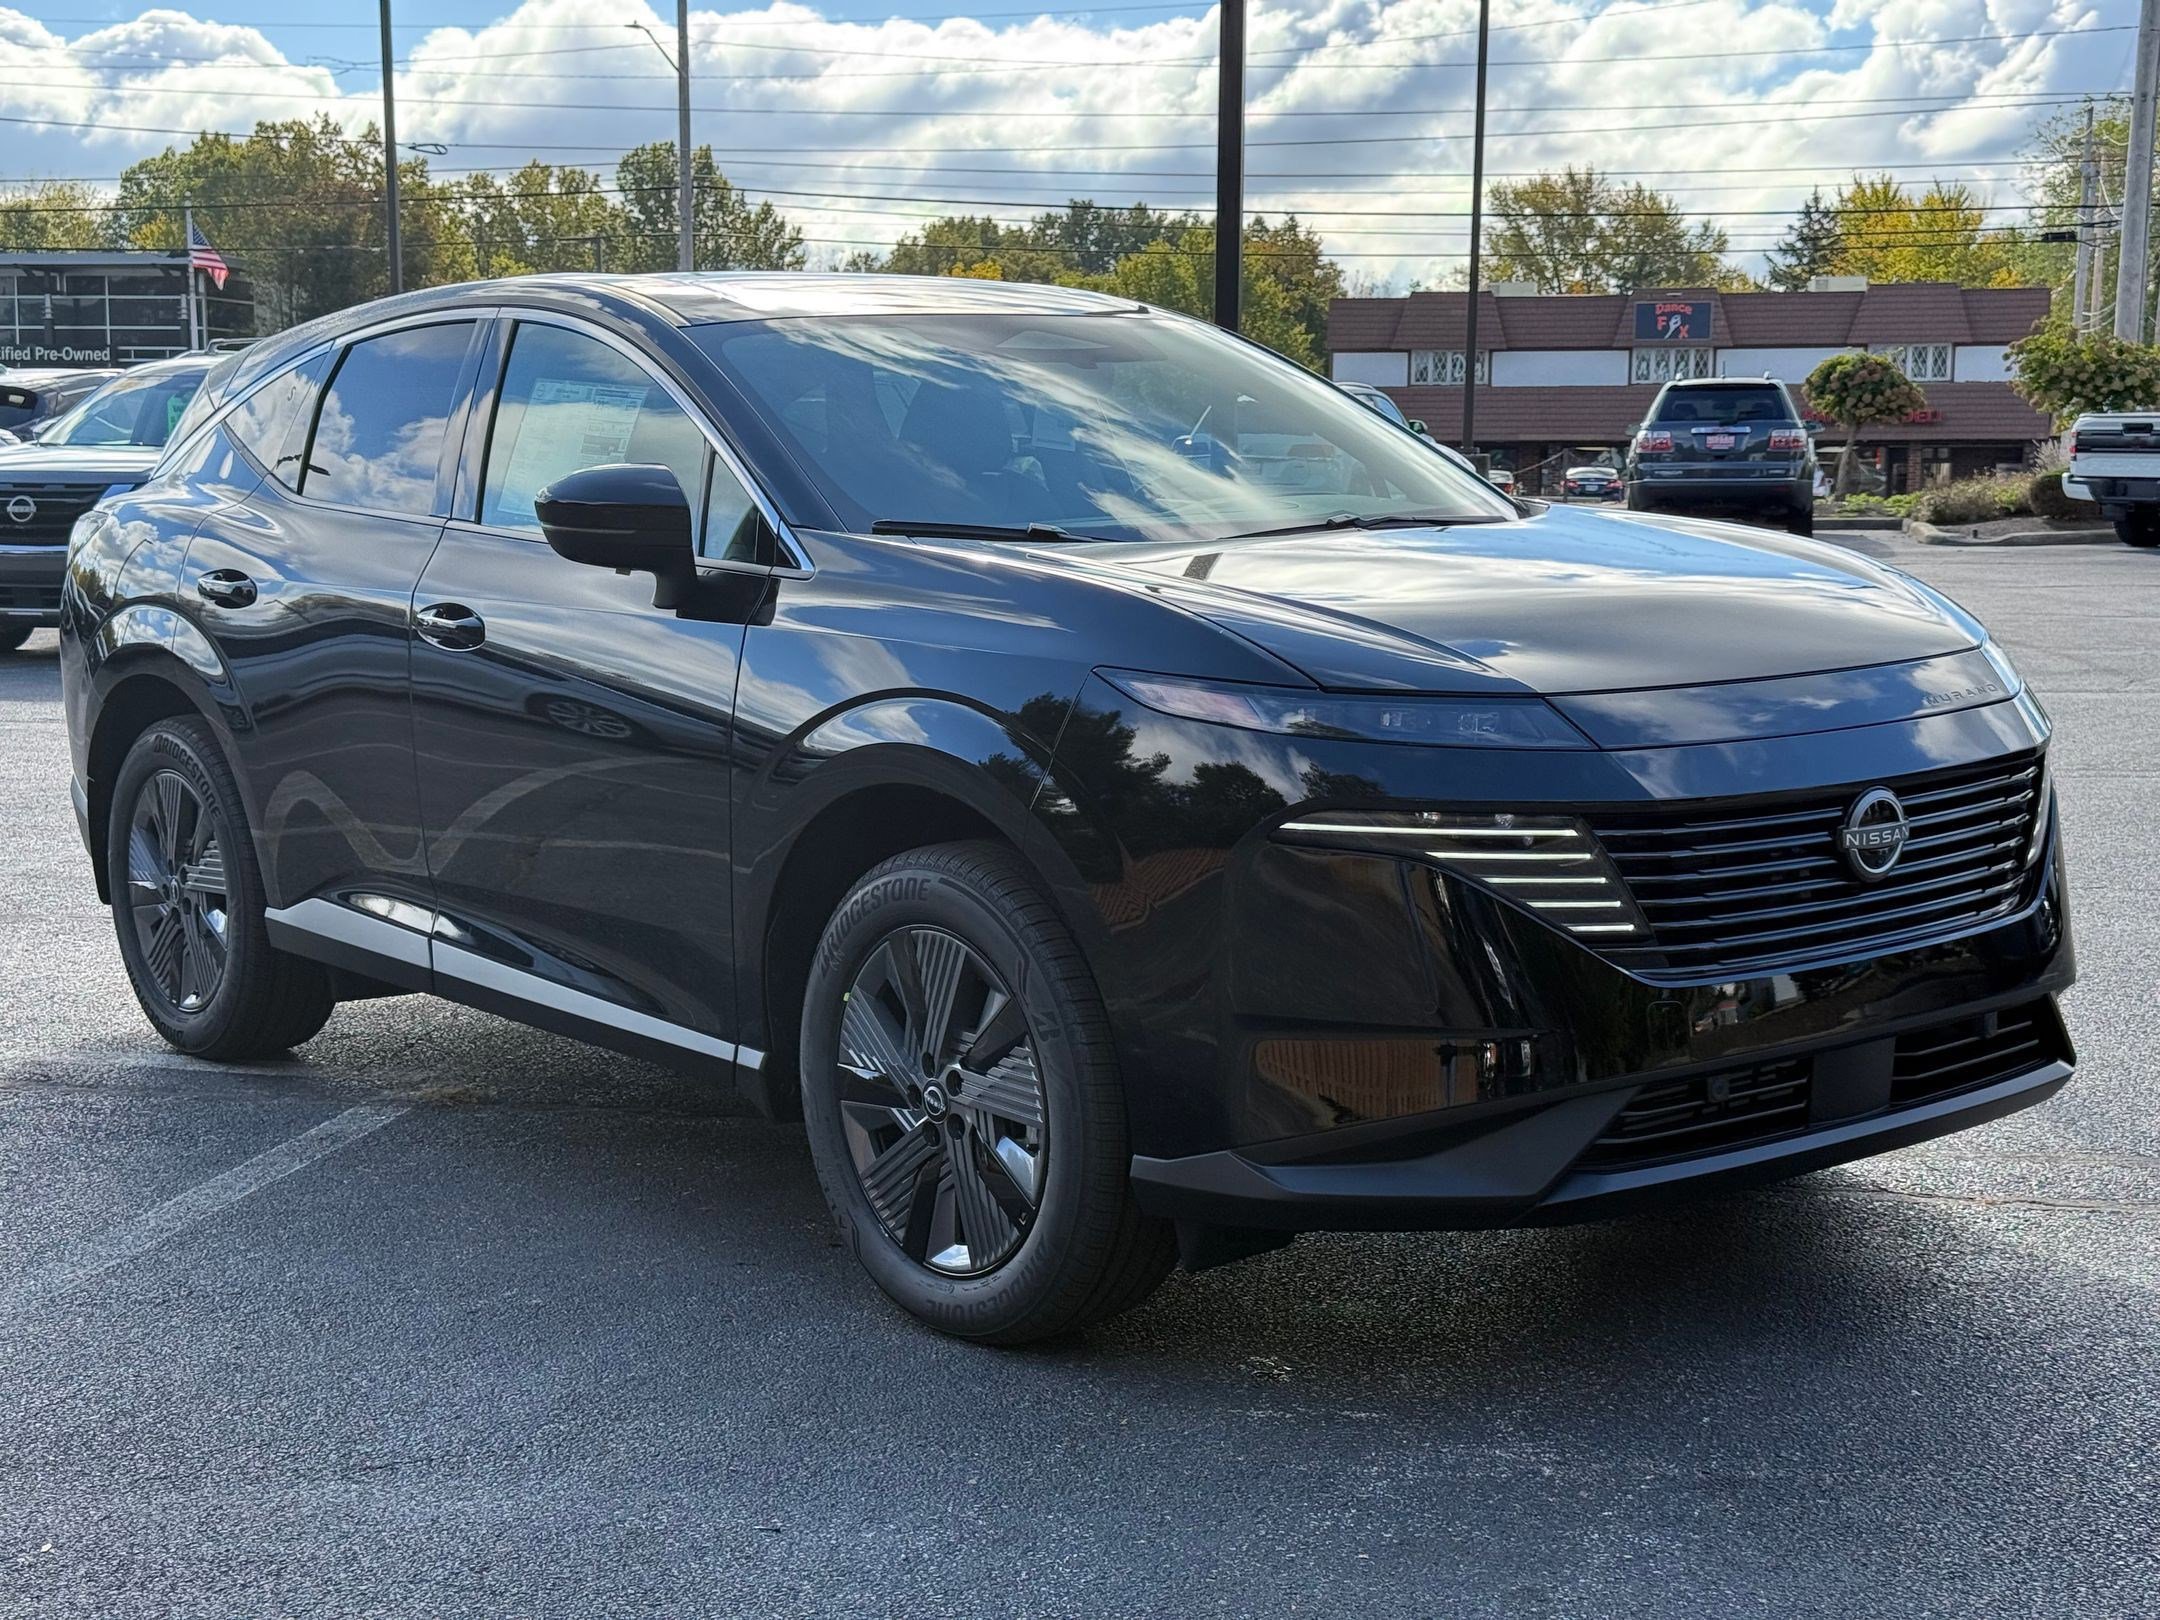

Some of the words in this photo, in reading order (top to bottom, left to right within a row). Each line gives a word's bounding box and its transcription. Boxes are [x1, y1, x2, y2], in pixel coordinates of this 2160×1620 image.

[1655, 303, 1693, 315] Dance
[35, 346, 111, 361] Pre-Owned
[1925, 683, 1999, 706] MURANO
[153, 734, 222, 818] BRIDGESTONE
[1845, 825, 1910, 847] NISSAN
[816, 876, 933, 979] BRIDGESTONE
